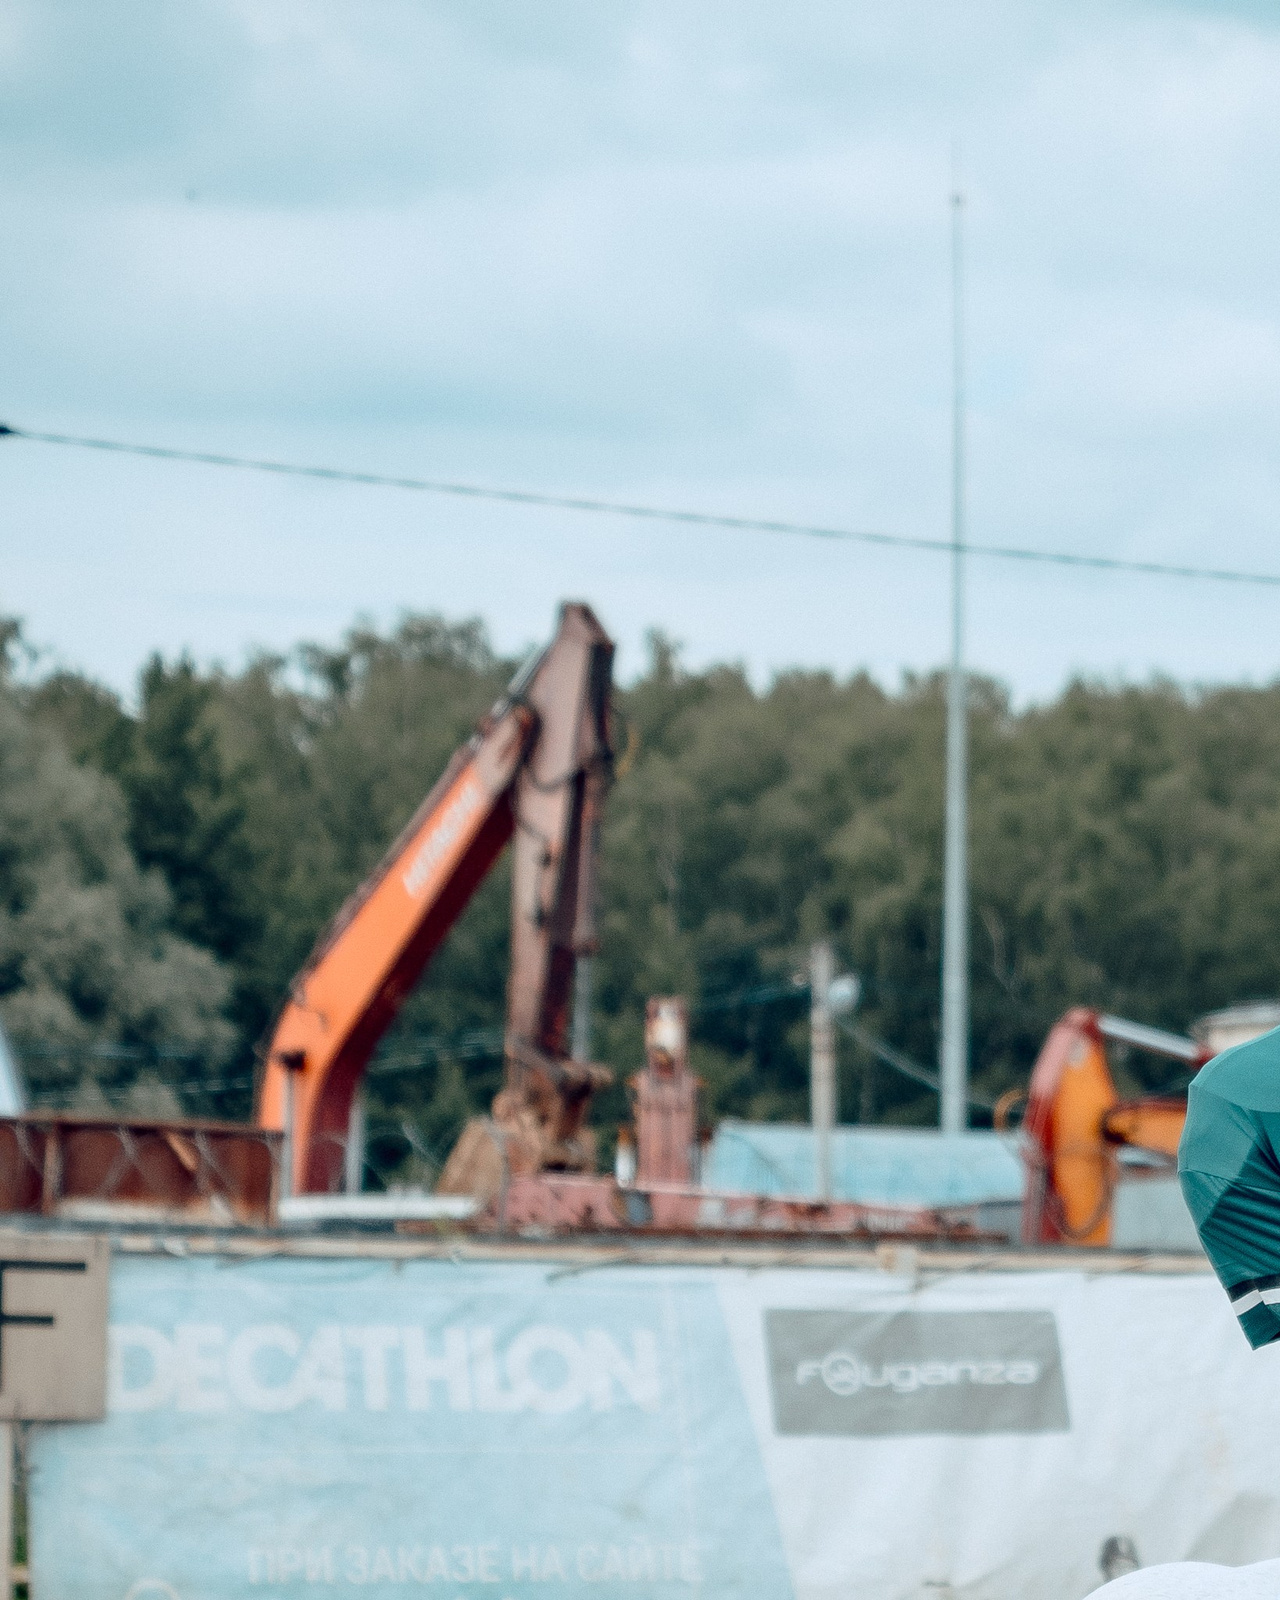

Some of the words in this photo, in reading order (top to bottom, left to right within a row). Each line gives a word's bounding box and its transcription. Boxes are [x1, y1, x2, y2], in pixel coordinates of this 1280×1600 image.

[0, 1259, 86, 1392] F
[106, 1322, 662, 1413] DECATHLON
[247, 1547, 336, 1584] ПРИ
[346, 1544, 501, 1584] ЗАКАЗЕ
[511, 1545, 568, 1583] НА
[576, 1535, 704, 1582] САЙТЕ
